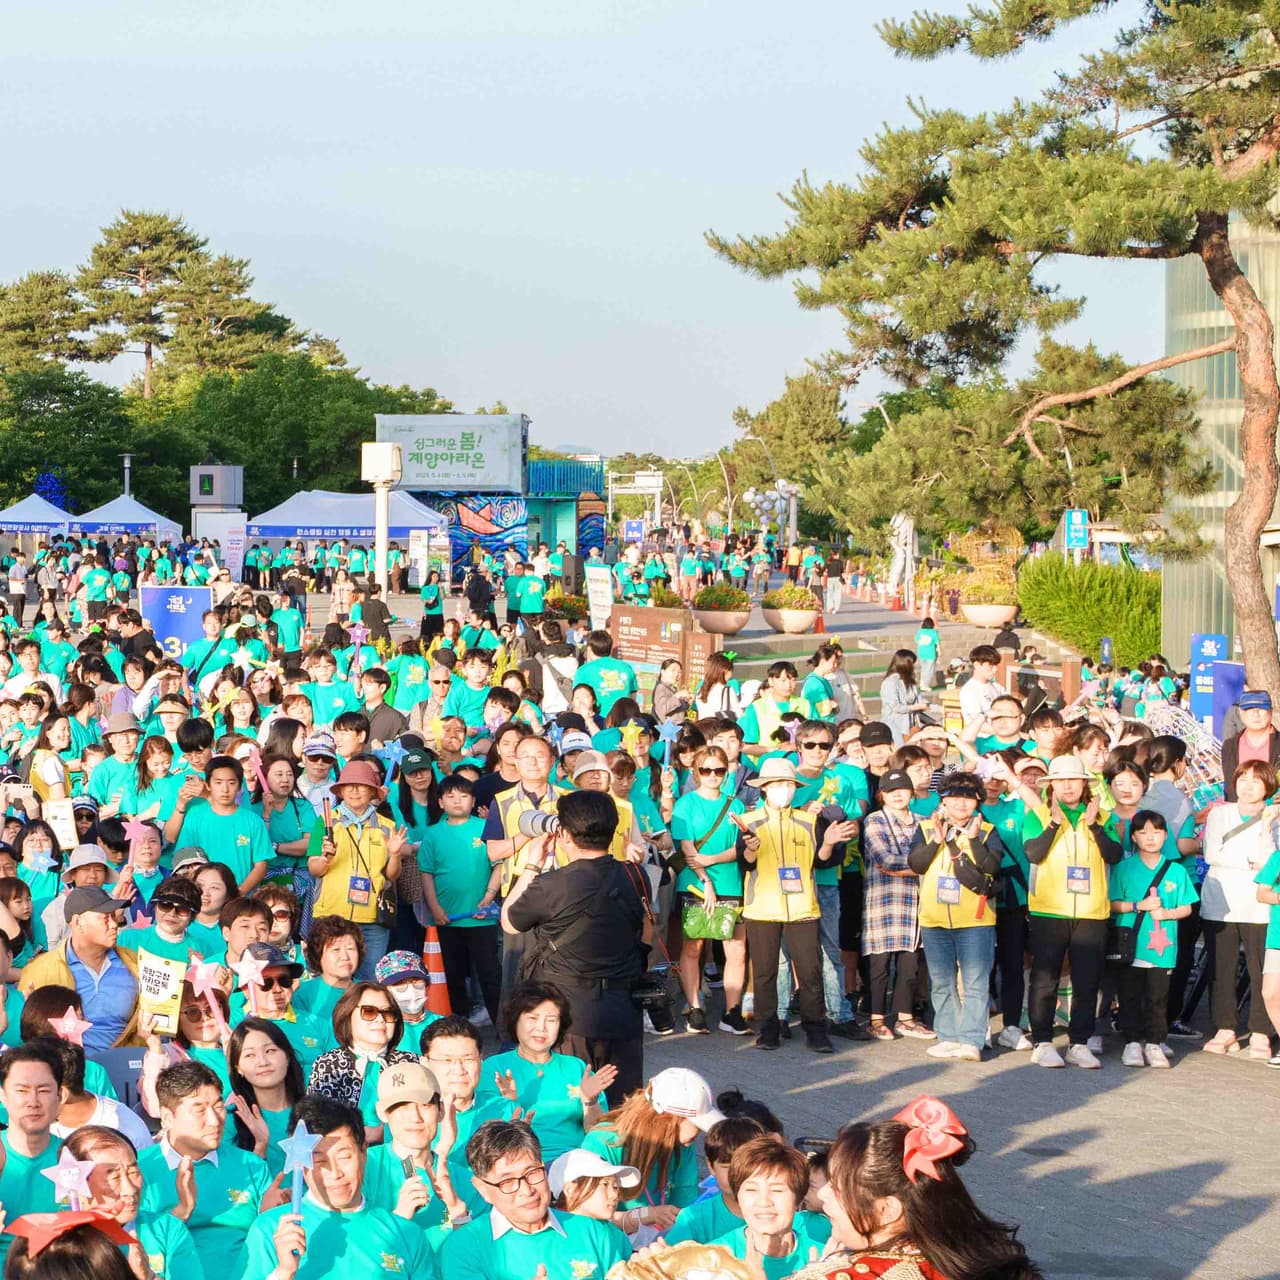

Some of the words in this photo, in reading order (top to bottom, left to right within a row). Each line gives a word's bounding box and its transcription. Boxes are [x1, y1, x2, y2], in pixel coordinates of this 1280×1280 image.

[414, 437, 457, 451] 싱그러운
[459, 431, 483, 451] 봄!
[407, 451, 486, 470] 계양아라온
